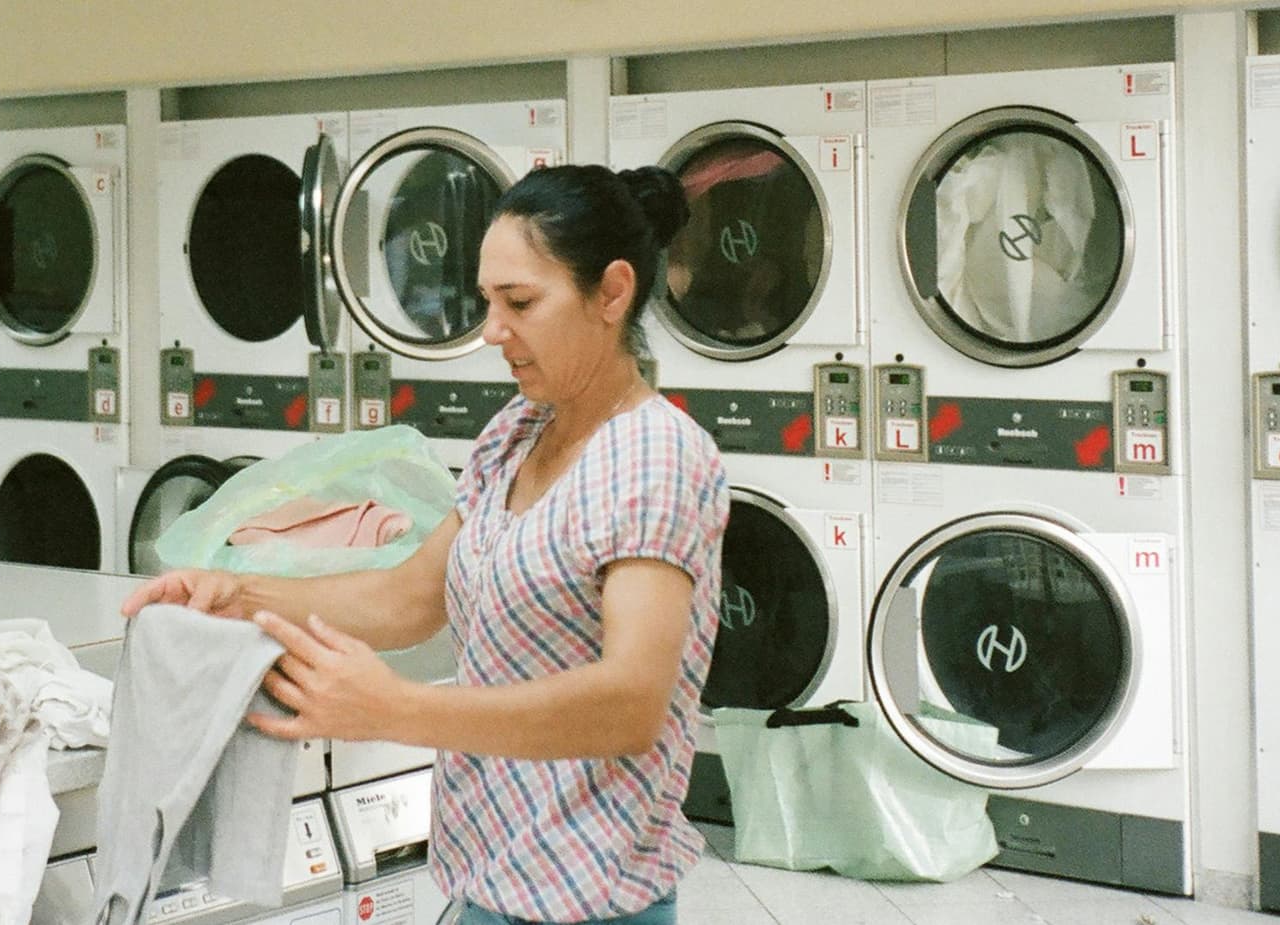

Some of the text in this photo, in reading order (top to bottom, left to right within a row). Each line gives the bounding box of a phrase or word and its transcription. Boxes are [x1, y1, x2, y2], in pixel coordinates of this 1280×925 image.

[1130, 135, 1146, 157] L
[832, 148, 838, 168] i
[174, 402, 184, 415] e
[325, 405, 332, 422] f
[368, 408, 379, 424] g
[835, 427, 848, 446] k
[896, 429, 910, 449] L
[1133, 443, 1156, 460] m
[834, 525, 847, 546] k
[1136, 551, 1160, 568] m
